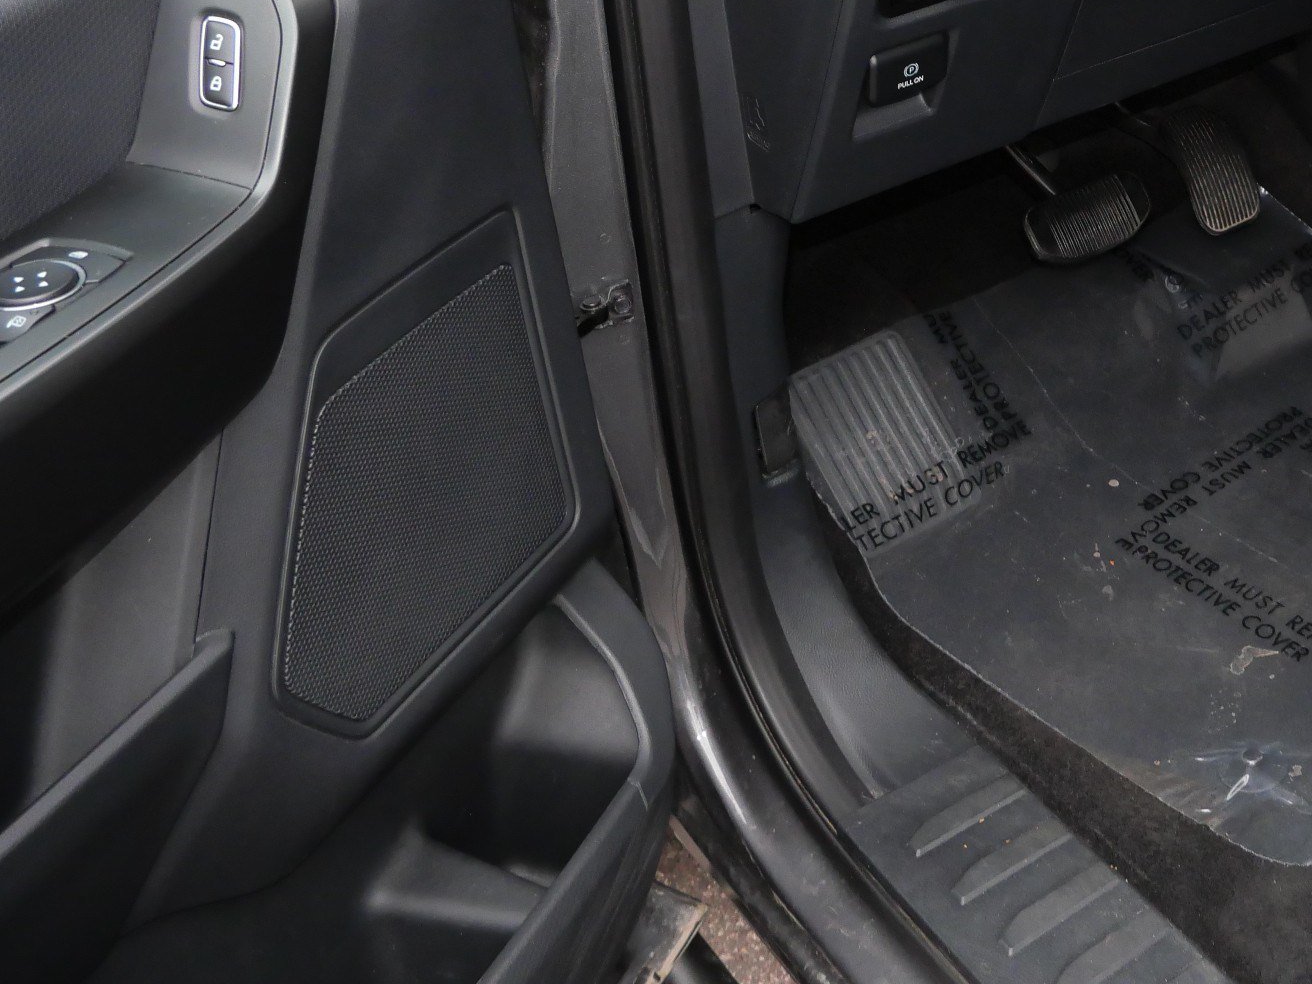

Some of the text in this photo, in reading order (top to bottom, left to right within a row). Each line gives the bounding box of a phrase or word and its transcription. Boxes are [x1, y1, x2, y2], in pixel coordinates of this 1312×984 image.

[897, 74, 924, 90] PULL ON
[1176, 289, 1242, 341] DEALER
[1190, 288, 1288, 359] PROTECTIVE
[838, 420, 1032, 532] LER MUST REMOVE
[855, 462, 1005, 552] TECTIVE COVER
[1137, 472, 1202, 511] COVER
[1204, 461, 1252, 496] MUST
[1131, 544, 1310, 663] PROTECTIVE COVER
[1152, 532, 1222, 577] DEALER
[1224, 577, 1286, 616] MUST
